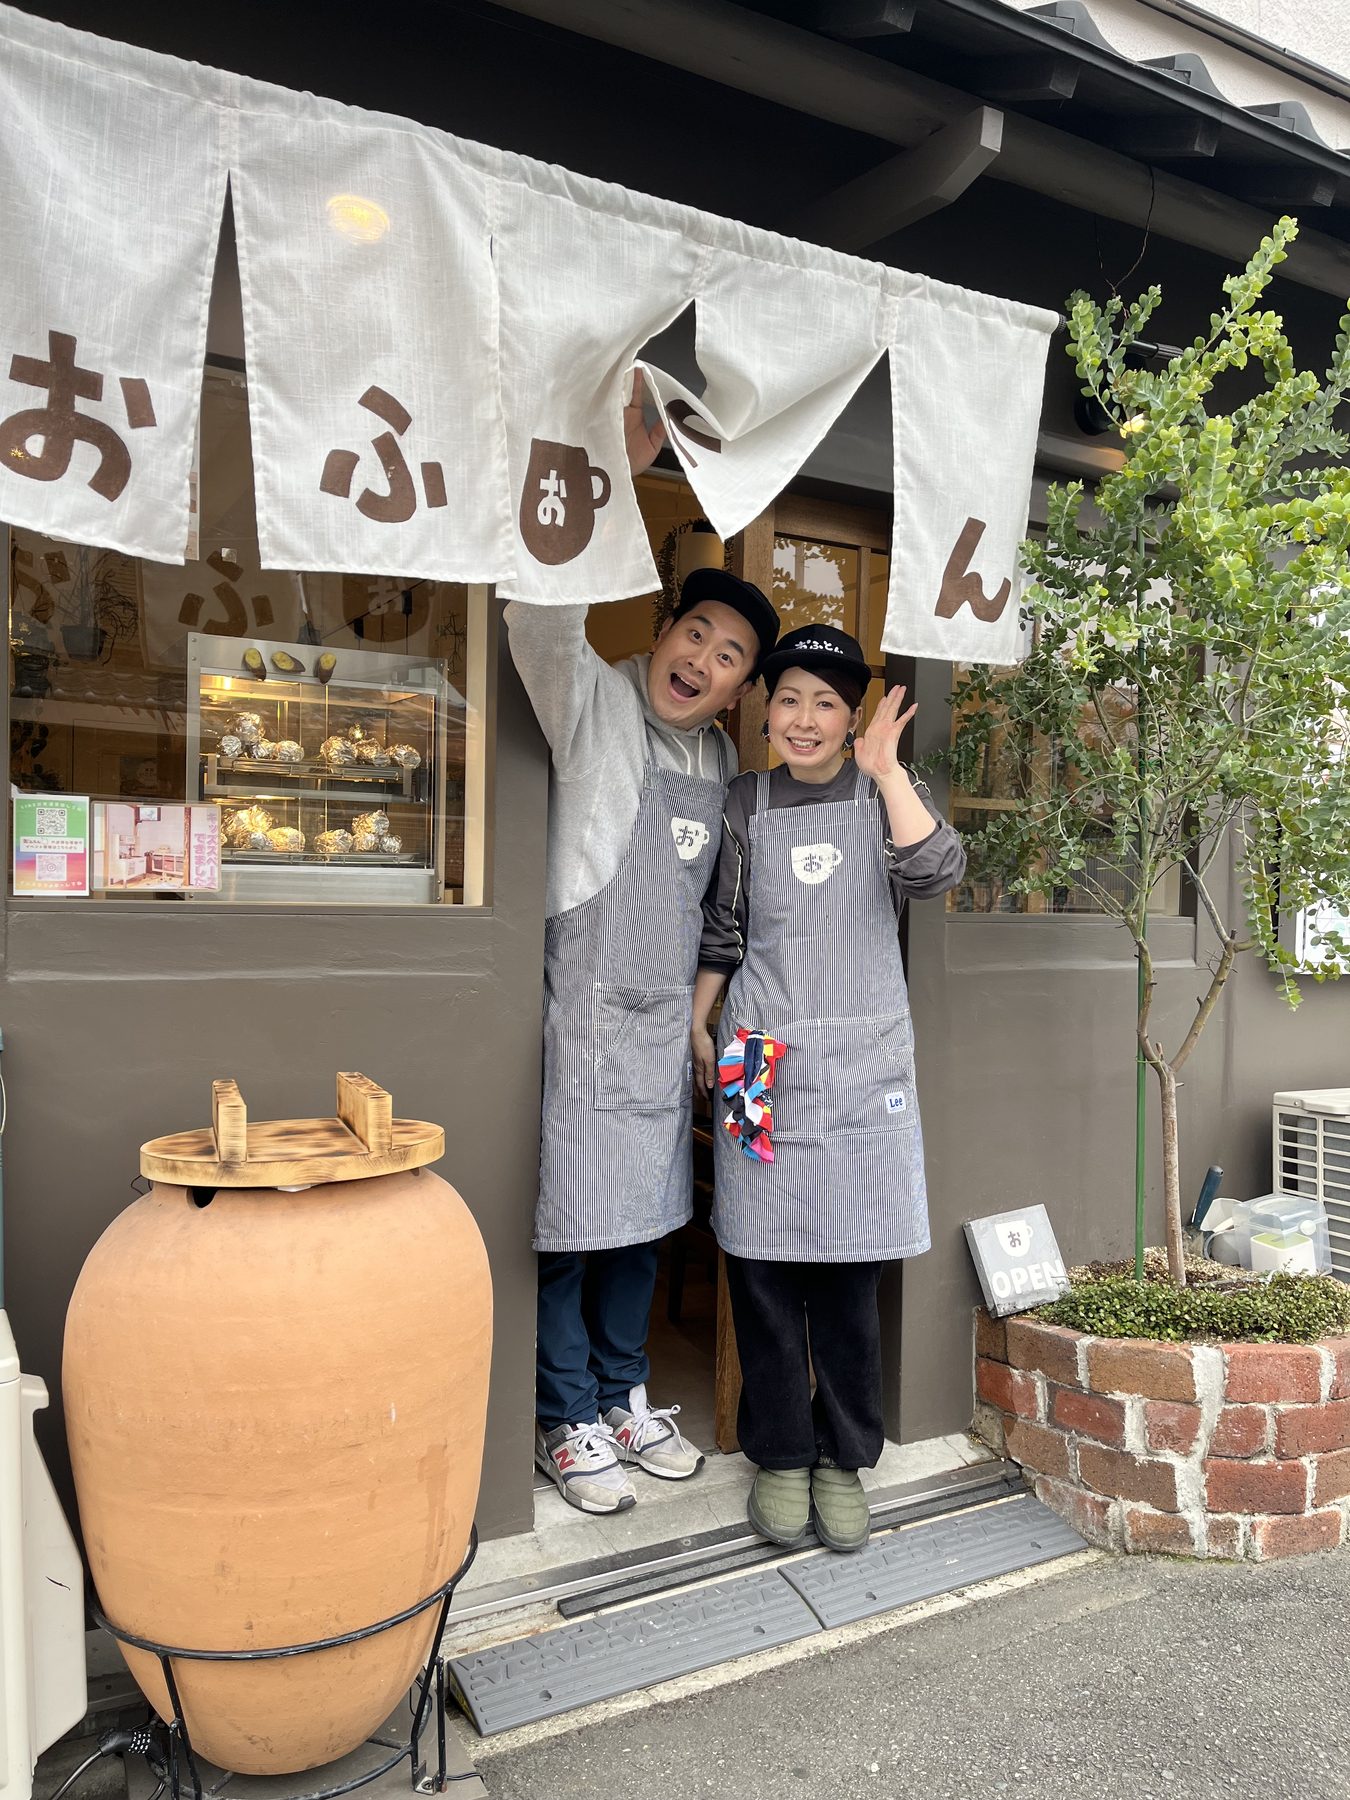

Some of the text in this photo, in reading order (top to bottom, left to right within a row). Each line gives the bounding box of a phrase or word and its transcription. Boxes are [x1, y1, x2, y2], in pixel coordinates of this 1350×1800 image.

[0, 330, 448, 523] お ふ
[537, 469, 567, 528] お
[934, 516, 1012, 623] ん
[794, 639, 844, 654] おふとん
[206, 813, 218, 887] キッズスペース
[675, 826, 700, 847] お
[193, 833, 206, 887] できました
[803, 853, 824, 873] お
[889, 1097, 904, 1108] Lee
[1008, 1231, 1022, 1248] お
[991, 1260, 1067, 1299] OPEN
[554, 1447, 576, 1471] N
